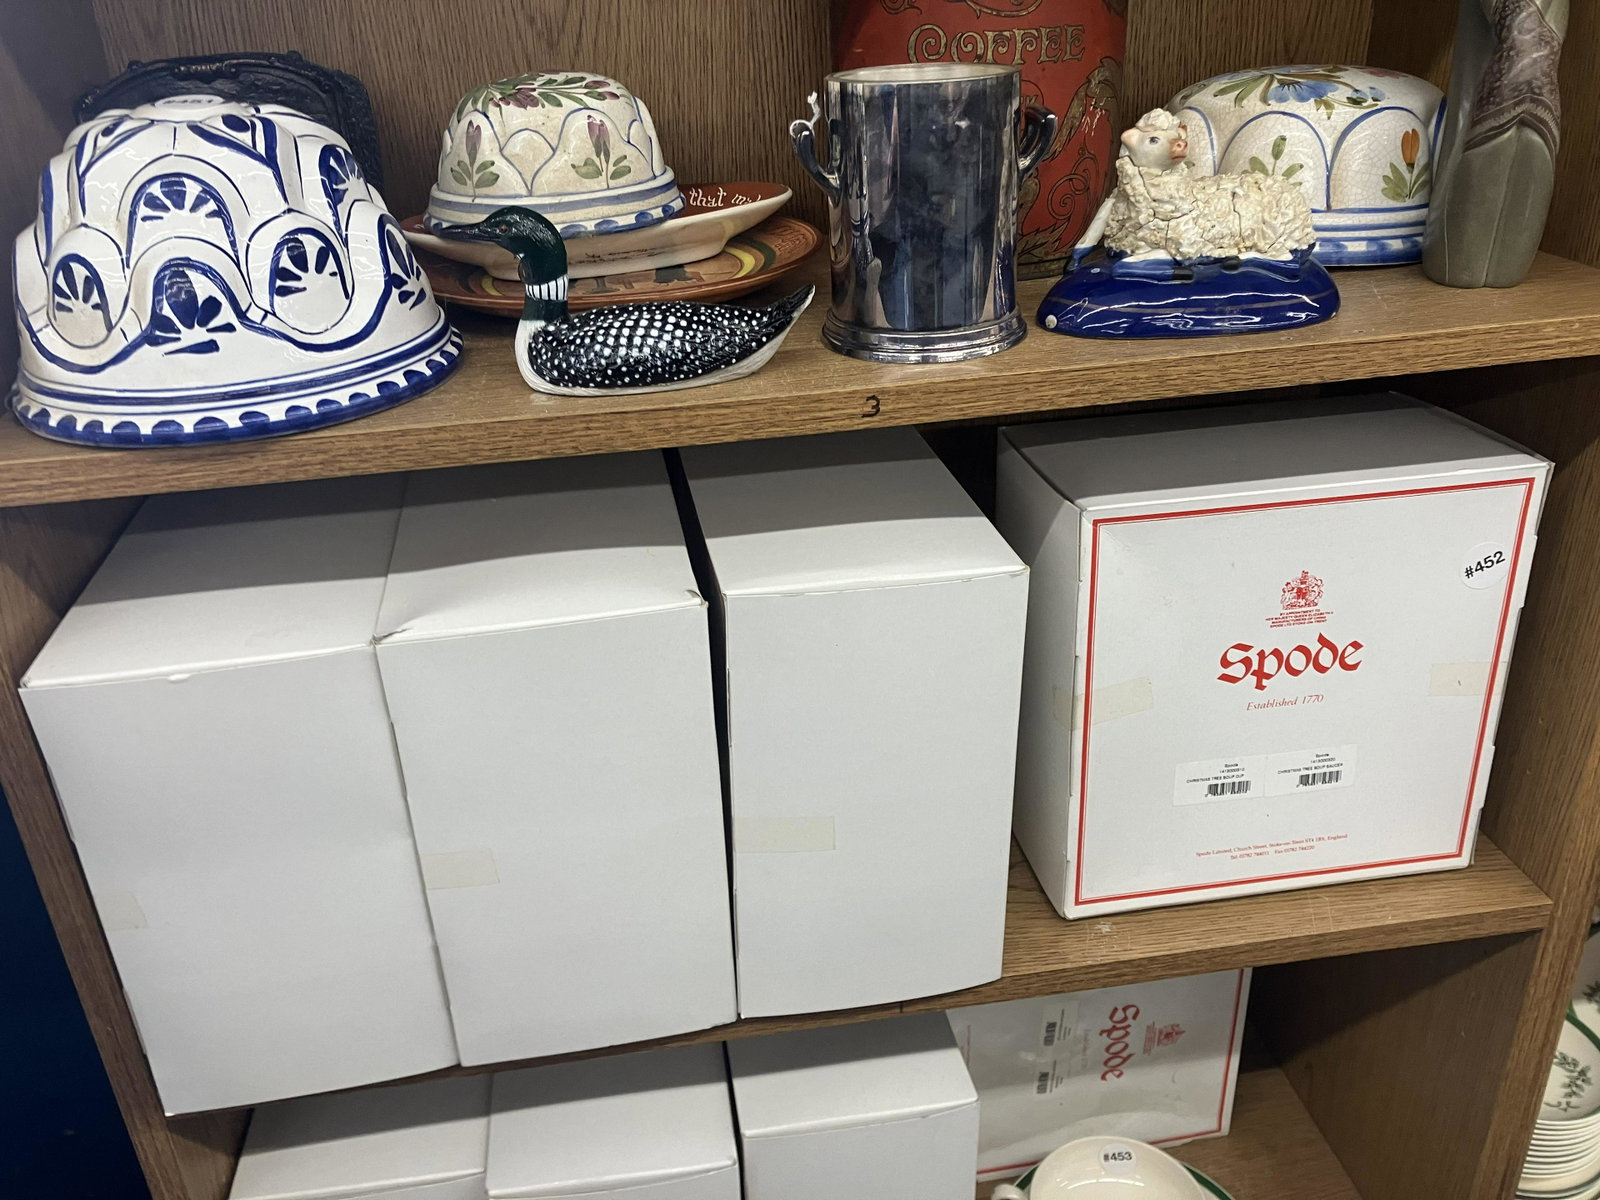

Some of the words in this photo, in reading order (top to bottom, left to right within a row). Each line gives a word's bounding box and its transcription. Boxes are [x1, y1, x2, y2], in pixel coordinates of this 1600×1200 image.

[907, 24, 1086, 65] COFFEE
[689, 187, 727, 207] that
[861, 395, 880, 418] 3
[1465, 550, 1506, 579] #452
[1217, 632, 1364, 691] Spode
[1246, 696, 1299, 711] Established
[1302, 694, 1325, 704] 1770
[1098, 1004, 1140, 1081] Spode
[1103, 1151, 1132, 1163] #453
